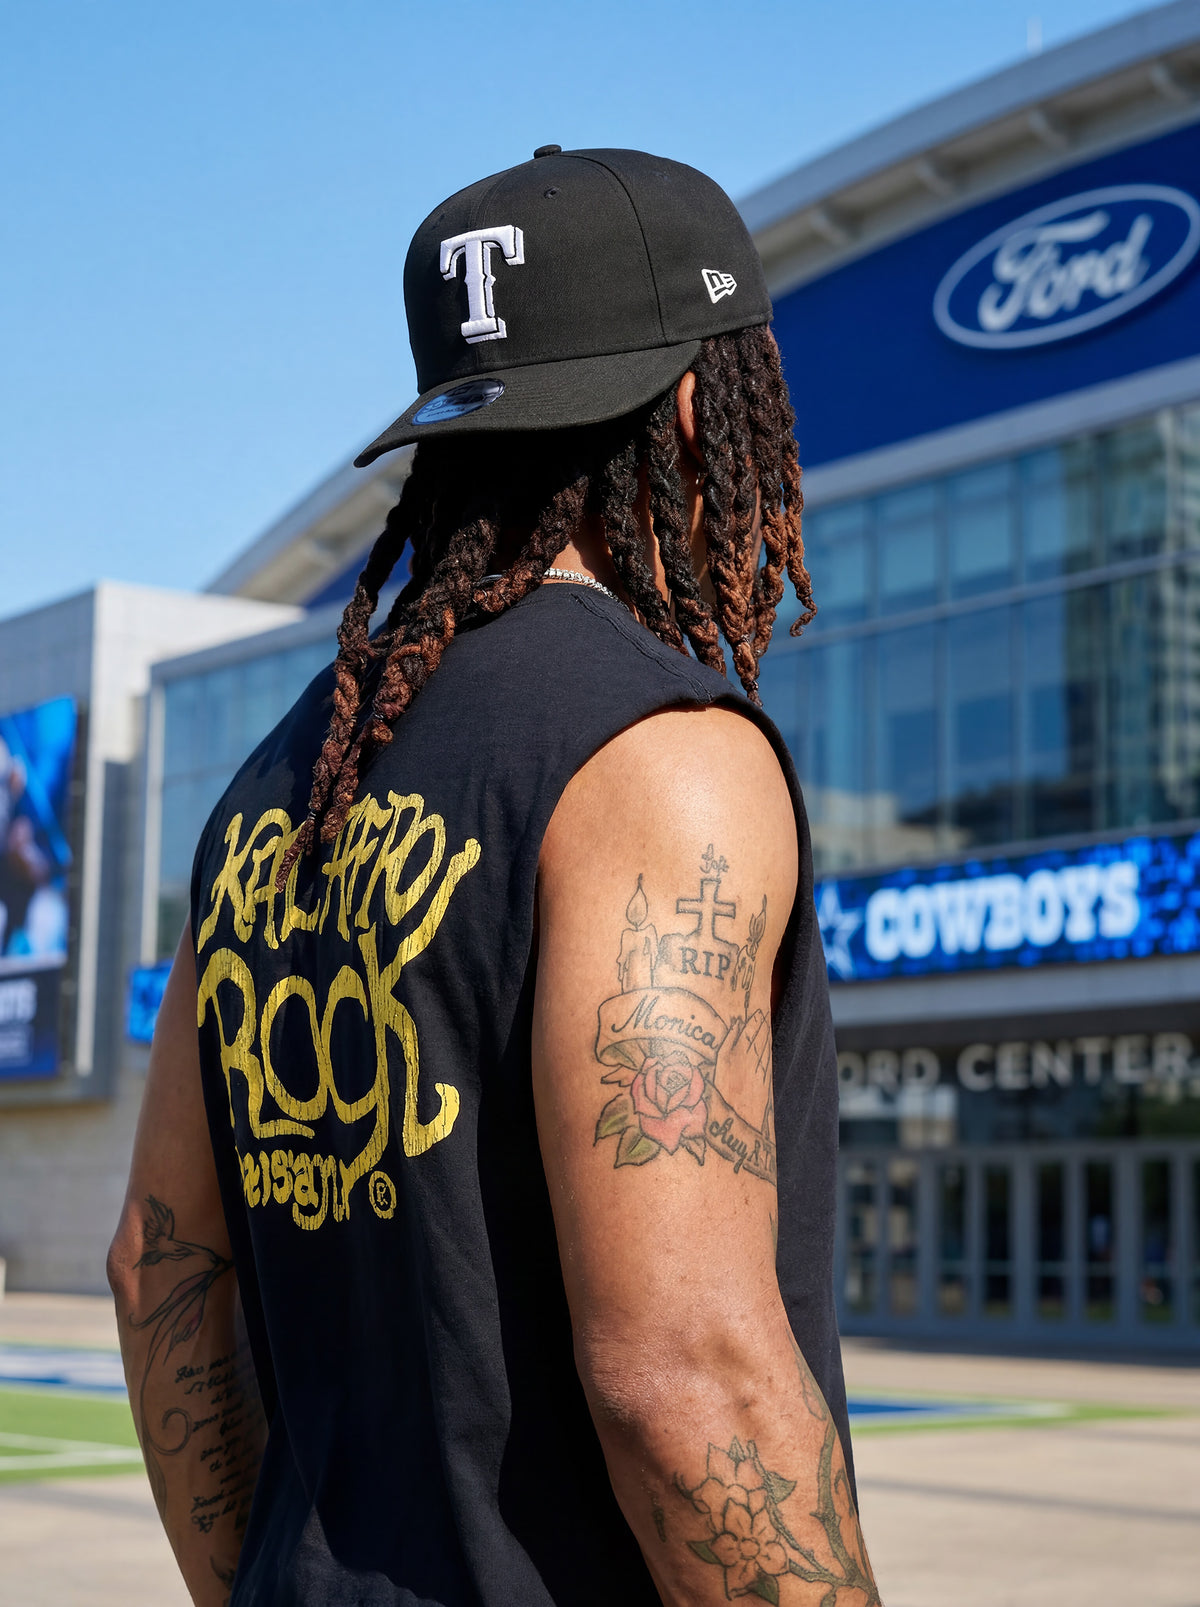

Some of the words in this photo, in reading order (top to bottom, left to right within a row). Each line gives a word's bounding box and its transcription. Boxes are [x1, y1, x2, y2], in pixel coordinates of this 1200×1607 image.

[439, 224, 526, 344] T
[977, 209, 1154, 333] Ford
[865, 861, 1141, 961] COWBOYS
[678, 947, 733, 980] RIP
[611, 994, 718, 1050] Monica
[837, 1047, 941, 1096] ORD
[956, 1031, 1196, 1092] CENTER
